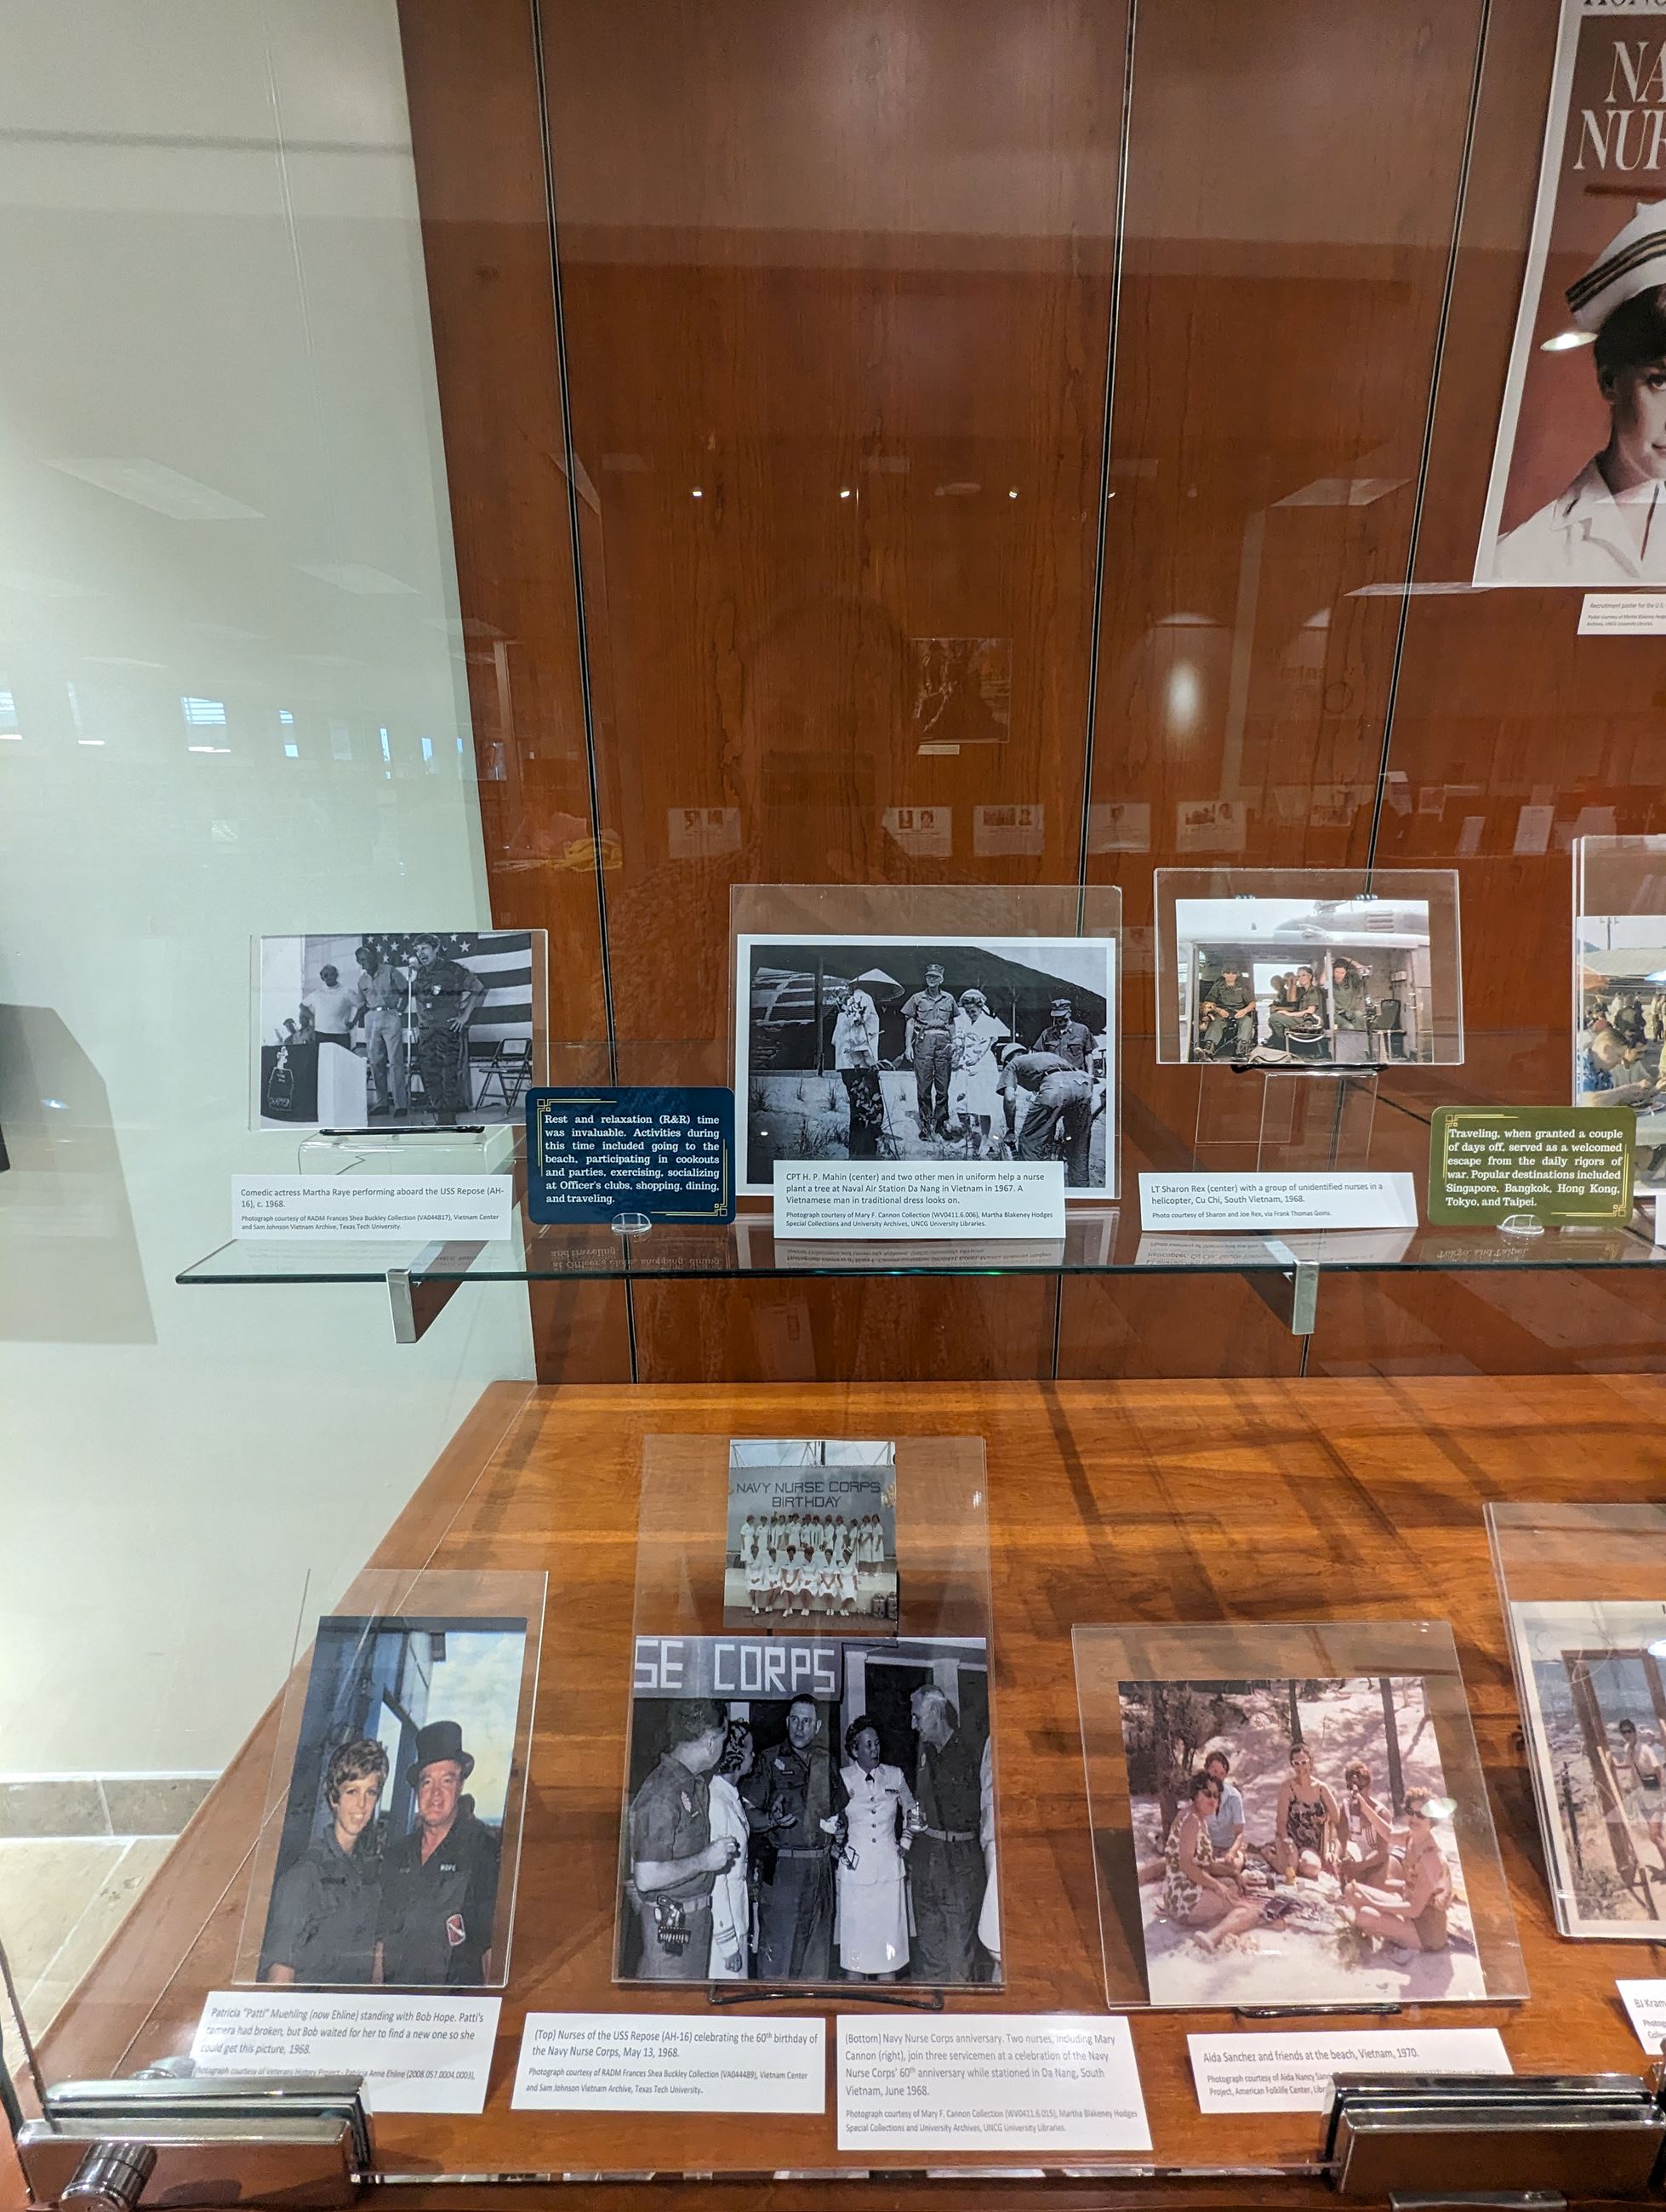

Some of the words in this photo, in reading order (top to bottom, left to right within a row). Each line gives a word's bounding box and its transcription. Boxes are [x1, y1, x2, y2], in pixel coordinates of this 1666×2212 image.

[544, 1115, 568, 1123] Rest
[574, 1115, 594, 1123] and
[601, 1115, 653, 1123] relaxation
[659, 1115, 690, 1126] (R&R)
[697, 1115, 719, 1124] time
[571, 1128, 626, 1137] invaluable.
[632, 1128, 681, 1137] Activities
[687, 1128, 719, 1139] during
[1448, 1128, 1500, 1140] Traveling,
[1503, 1129, 1532, 1137] when
[1535, 1129, 1575, 1140] granted
[1589, 1129, 1623, 1140] couple
[545, 1141, 565, 1149] this
[572, 1141, 595, 1149] time
[602, 1141, 644, 1149] included
[651, 1142, 678, 1152] going
[702, 1142, 719, 1150] the
[1447, 1142, 1459, 1151] of
[1461, 1143, 1486, 1154] days
[1488, 1142, 1505, 1153] off,
[1508, 1143, 1543, 1151] served
[1571, 1143, 1622, 1152] welcomed
[545, 1154, 578, 1164] beach,
[585, 1154, 650, 1166] participating
[658, 1154, 668, 1163] in
[676, 1154, 719, 1164] cookouts
[1446, 1158, 1481, 1167] escape
[1487, 1155, 1512, 1165] from
[1518, 1156, 1536, 1165] the
[1541, 1156, 1568, 1167] daily
[1574, 1156, 1605, 1167] rigors
[1611, 1156, 1623, 1166] of
[545, 1167, 565, 1176] and
[568, 1167, 607, 1178] parties,
[610, 1168, 664, 1178] exercising,
[667, 1168, 719, 1179] socializing
[848, 1173, 879, 1183] (center)
[997, 1173, 1015, 1183] help
[1470, 1170, 1510, 1181] Popular
[1511, 1170, 1575, 1179] destinations
[1577, 1170, 1620, 1179] included
[559, 1181, 602, 1189] Officer's
[603, 1181, 633, 1190] clubs,
[636, 1181, 682, 1192] shopping,
[685, 1181, 719, 1192] dining,
[1446, 1183, 1499, 1194] Singapore,
[1504, 1183, 1552, 1194] Bangkok,
[1557, 1183, 1585, 1195] Hong
[1589, 1183, 1620, 1195] Kong,
[332, 1189, 351, 1198] Raye
[352, 1188, 395, 1197] performing
[456, 1187, 485, 1197] Repose
[487, 1187, 504, 1196] (AH-
[242, 1200, 255, 1210] 16),
[545, 1194, 565, 1202] and
[567, 1194, 614, 1205] traveling.
[1151, 1197, 1194, 1206] helicopter,
[1207, 1196, 1223, 1205] Chi,
[1247, 1195, 1283, 1204] Vietnam,
[1445, 1197, 1480, 1208] Tokyo,
[1481, 1197, 1501, 1206] and
[1502, 1197, 1537, 1208] Taipei.
[736, 1482, 771, 1493] NAVY
[775, 1482, 825, 1493] NURSE
[829, 1481, 881, 1493] CORPS
[772, 1497, 842, 1508] BIRTHDAY
[633, 1639, 683, 1689] SE
[714, 1643, 835, 1693] CORPS
[200, 2044, 222, 2053] could
[223, 2044, 237, 2055] get
[239, 2044, 254, 2053] this
[255, 2045, 286, 2055] picture,
[288, 2044, 311, 2054] 1968.
[532, 2046, 545, 2055] the
[547, 2046, 568, 2058] Navy
[569, 2046, 594, 2056] Nurse
[595, 2046, 621, 2058] Corps,
[623, 2047, 642, 2058] May
[642, 2047, 656, 2059] 13,
[658, 2047, 680, 2057] 1968.
[1203, 2052, 1221, 2062] Aida
[1223, 2052, 1256, 2062] Sanchez
[1258, 2051, 1274, 2061] and
[1275, 2050, 1304, 2061] friends
[1304, 2051, 1314, 2060] at
[1315, 2050, 1329, 2060] the
[1330, 2050, 1358, 2061] beach,
[1358, 2049, 1395, 2060] Vietnam,
[1396, 2047, 1419, 2057] 1970.
[845, 2050, 876, 2060] Cannon
[878, 2050, 906, 2062] (right),
[908, 2050, 923, 2062] join
[925, 2050, 948, 2060] three
[997, 2051, 1006, 2060] at
[1014, 2051, 1061, 2060] celebration
[1062, 2050, 1071, 2061] of
[1072, 2051, 1087, 2061] the
[1088, 2051, 1109, 2062] Navy
[845, 2085, 883, 2097] Vietnam,
[885, 2086, 904, 2095] June
[906, 2085, 929, 2095] 1968.
